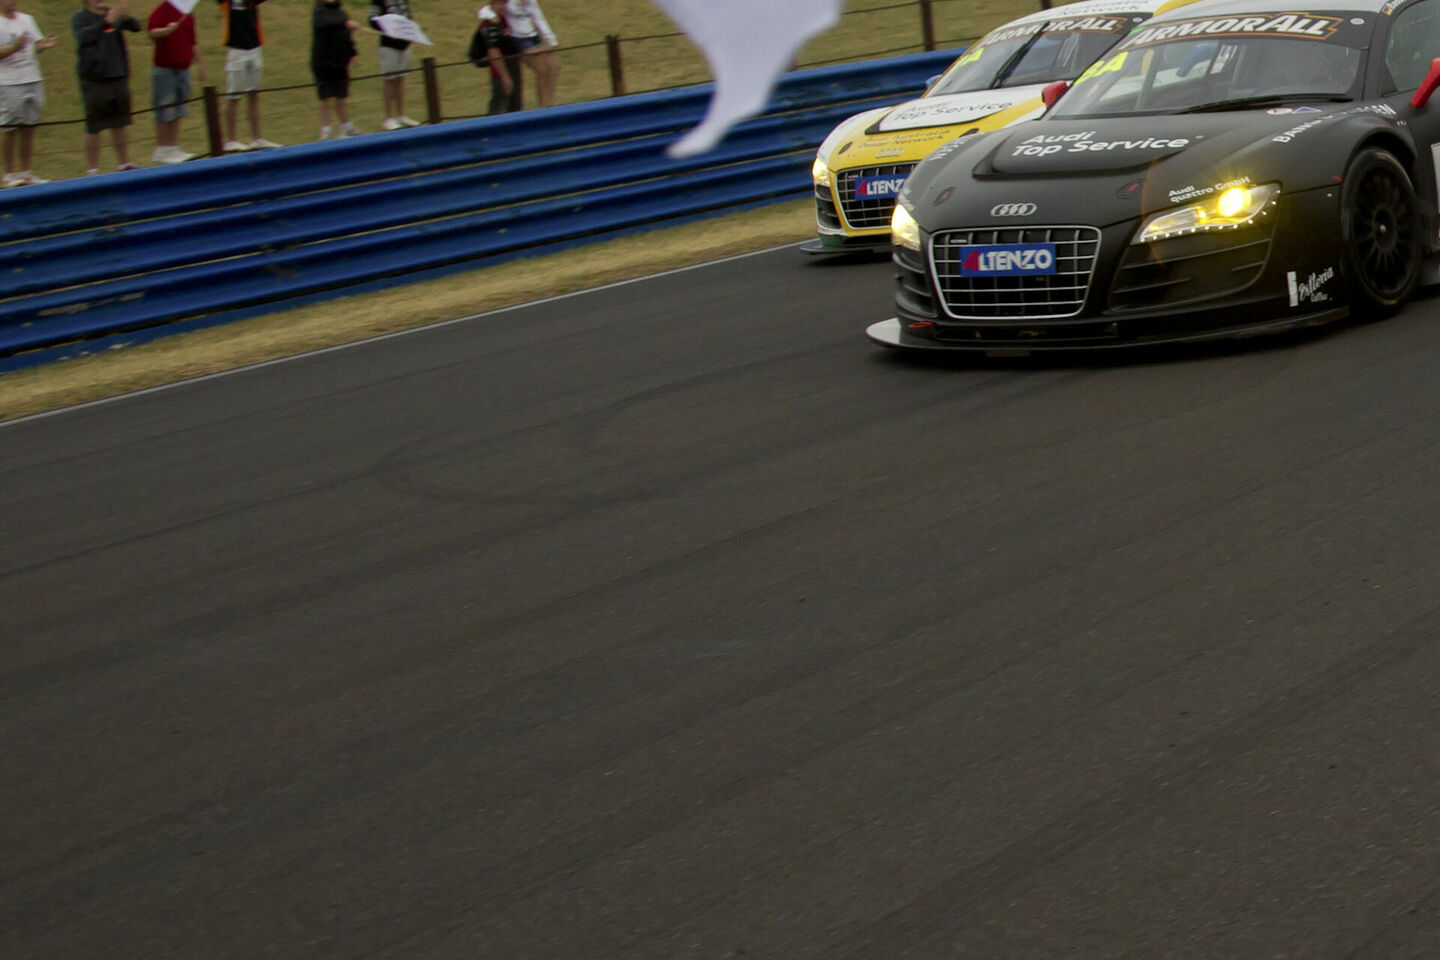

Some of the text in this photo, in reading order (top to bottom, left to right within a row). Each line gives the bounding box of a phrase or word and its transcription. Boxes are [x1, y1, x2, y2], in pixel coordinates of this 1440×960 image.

[1021, 131, 1096, 145] Audi
[1011, 137, 1190, 158] Top Service
[856, 179, 907, 197] ALTENZ
[1168, 185, 1195, 197] Audi
[1169, 187, 1213, 204] quattro
[963, 249, 1053, 272] ALTENZO
